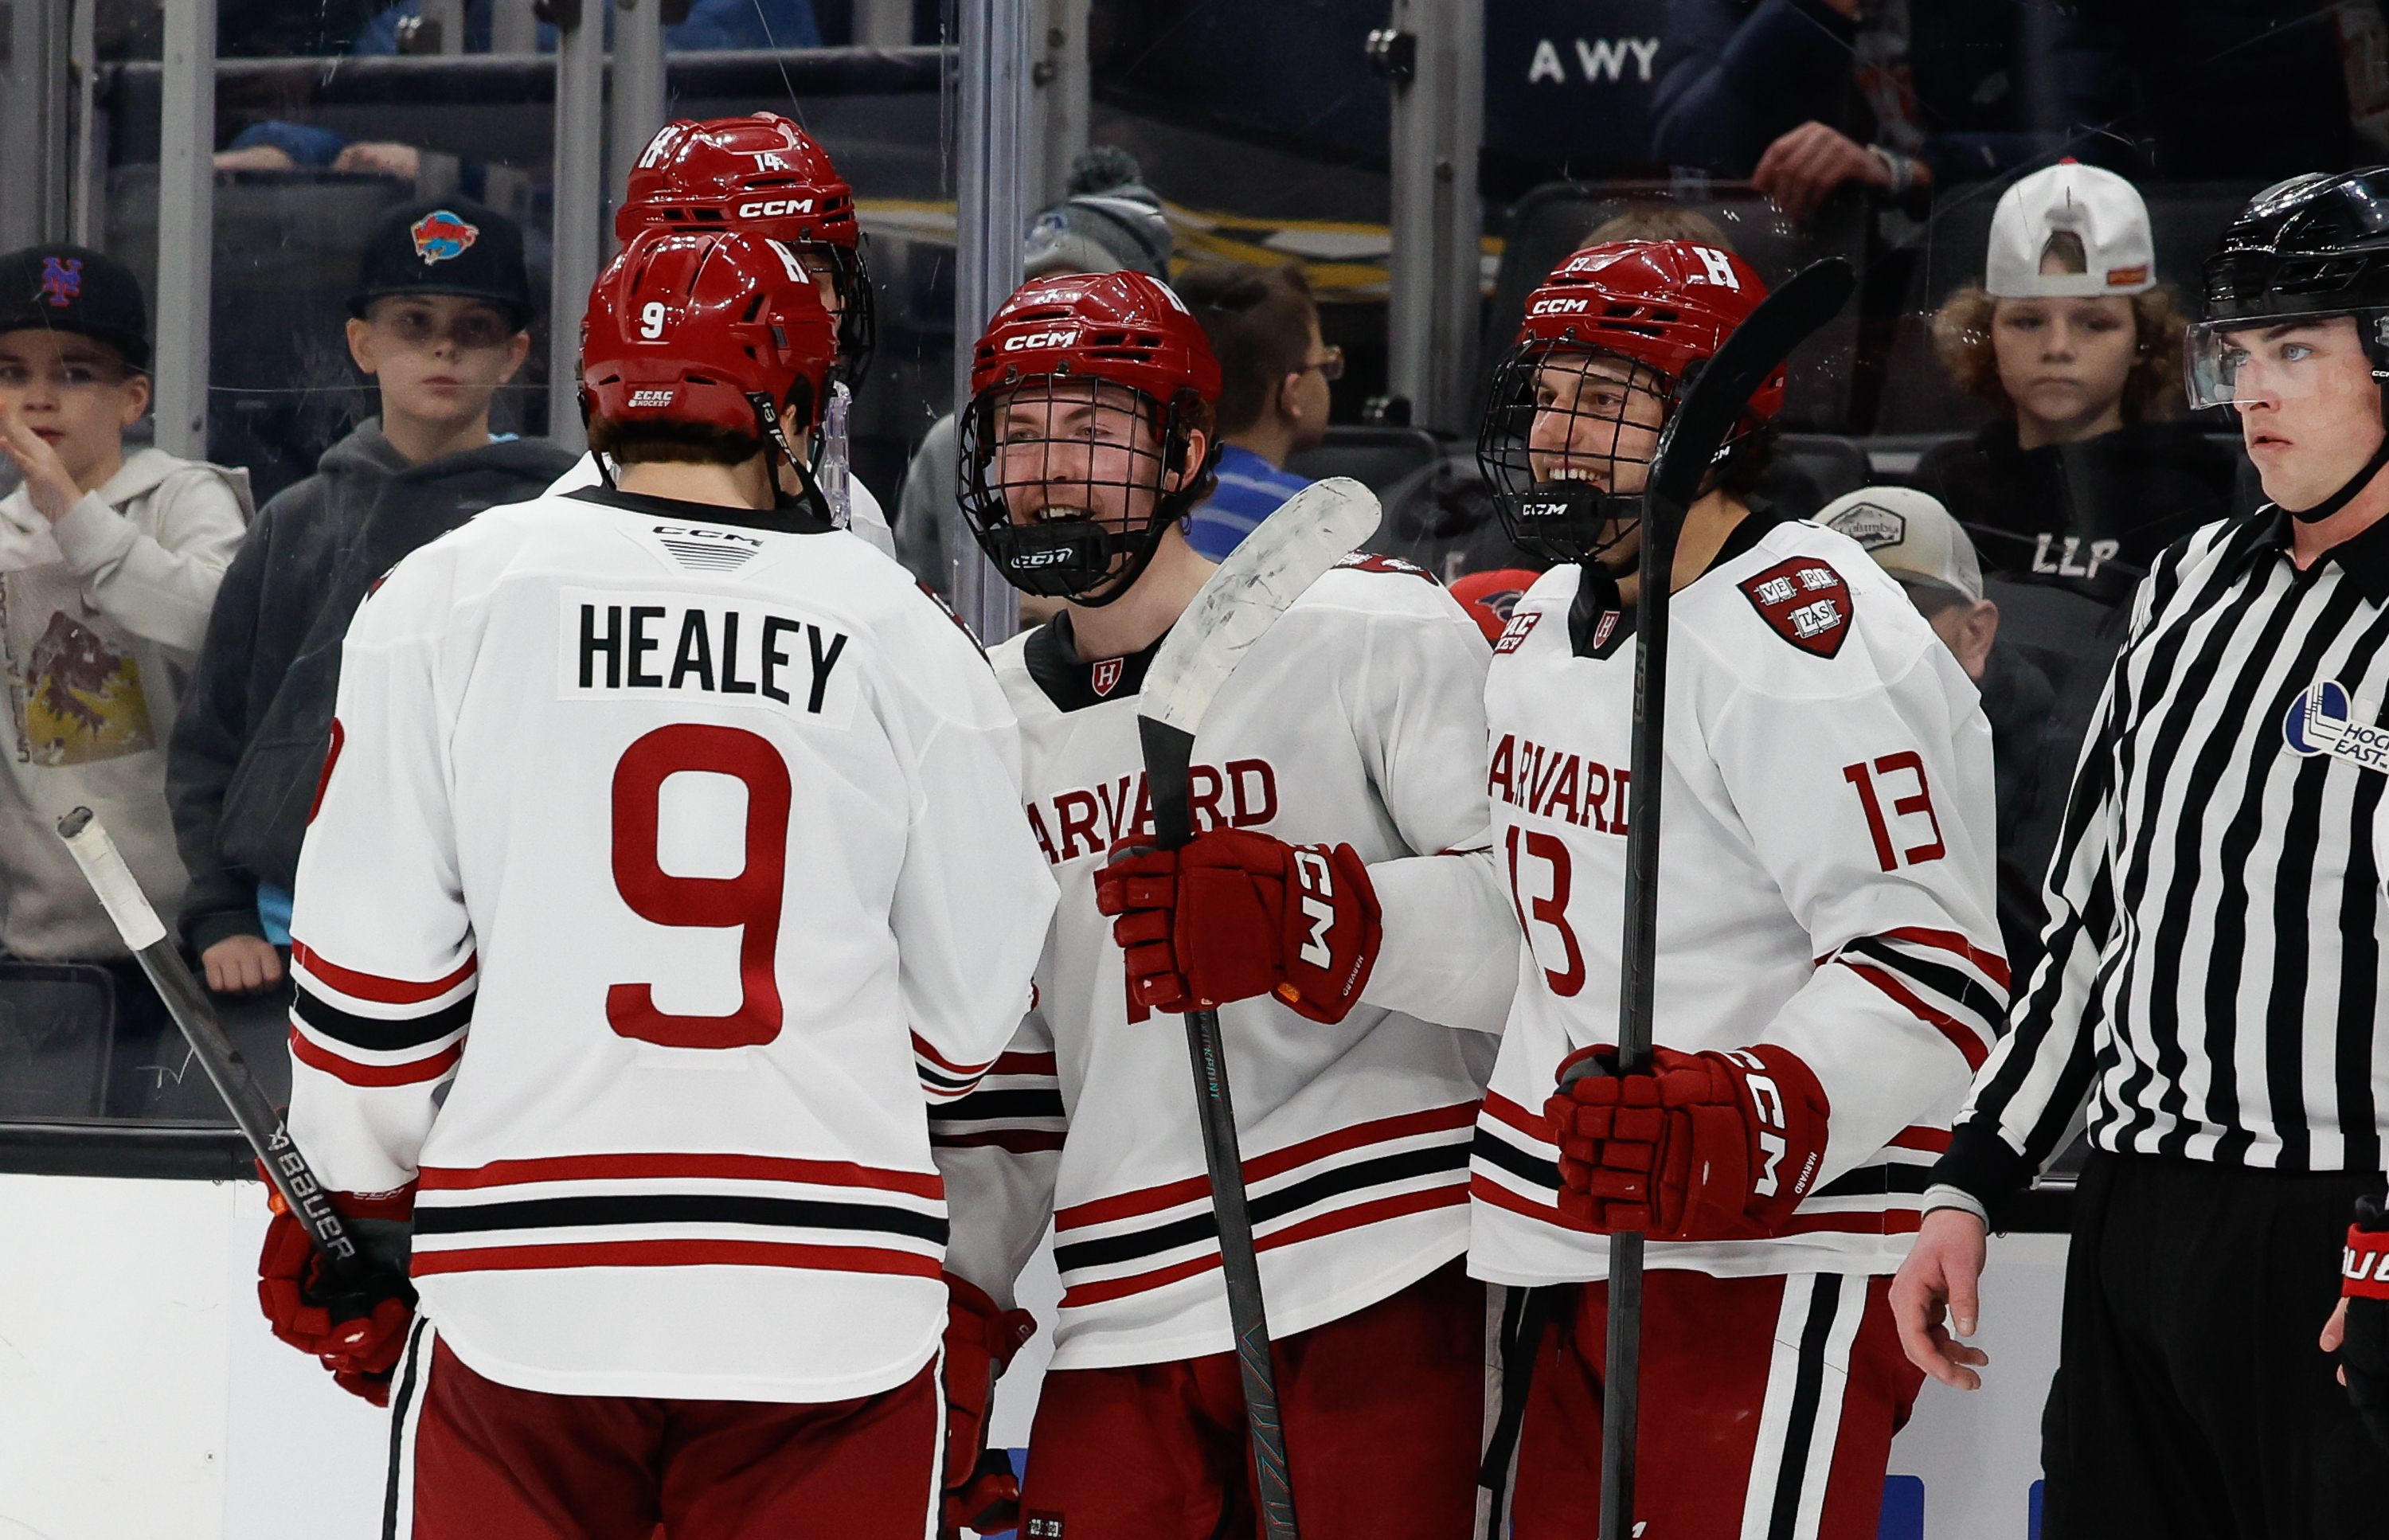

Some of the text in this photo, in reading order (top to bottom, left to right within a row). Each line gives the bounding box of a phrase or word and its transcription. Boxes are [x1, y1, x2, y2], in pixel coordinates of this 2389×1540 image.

[753, 153, 780, 172] 14
[738, 199, 813, 218] CCM
[1691, 246, 1740, 289] H
[640, 302, 666, 339] 9
[1533, 298, 1588, 315] CCM
[1004, 331, 1077, 351] CCM
[633, 390, 674, 401] ECAC
[652, 526, 764, 547] CCM
[2032, 532, 2120, 580] LLP
[1763, 572, 1827, 596] VE RI
[1598, 616, 1614, 638] H
[1799, 606, 1830, 627] TAS
[579, 604, 847, 713] HEALEY
[1097, 663, 1116, 686] H
[2334, 739, 2387, 764] EAST
[1026, 758, 1278, 865] ARVARD
[1844, 750, 1945, 872] 13
[606, 723, 792, 1049] 9
[1294, 846, 1335, 970] CM
[1506, 825, 1585, 997] 13
[1795, 1151, 1817, 1194] HARVARD
[279, 1152, 355, 1260] BAUER
